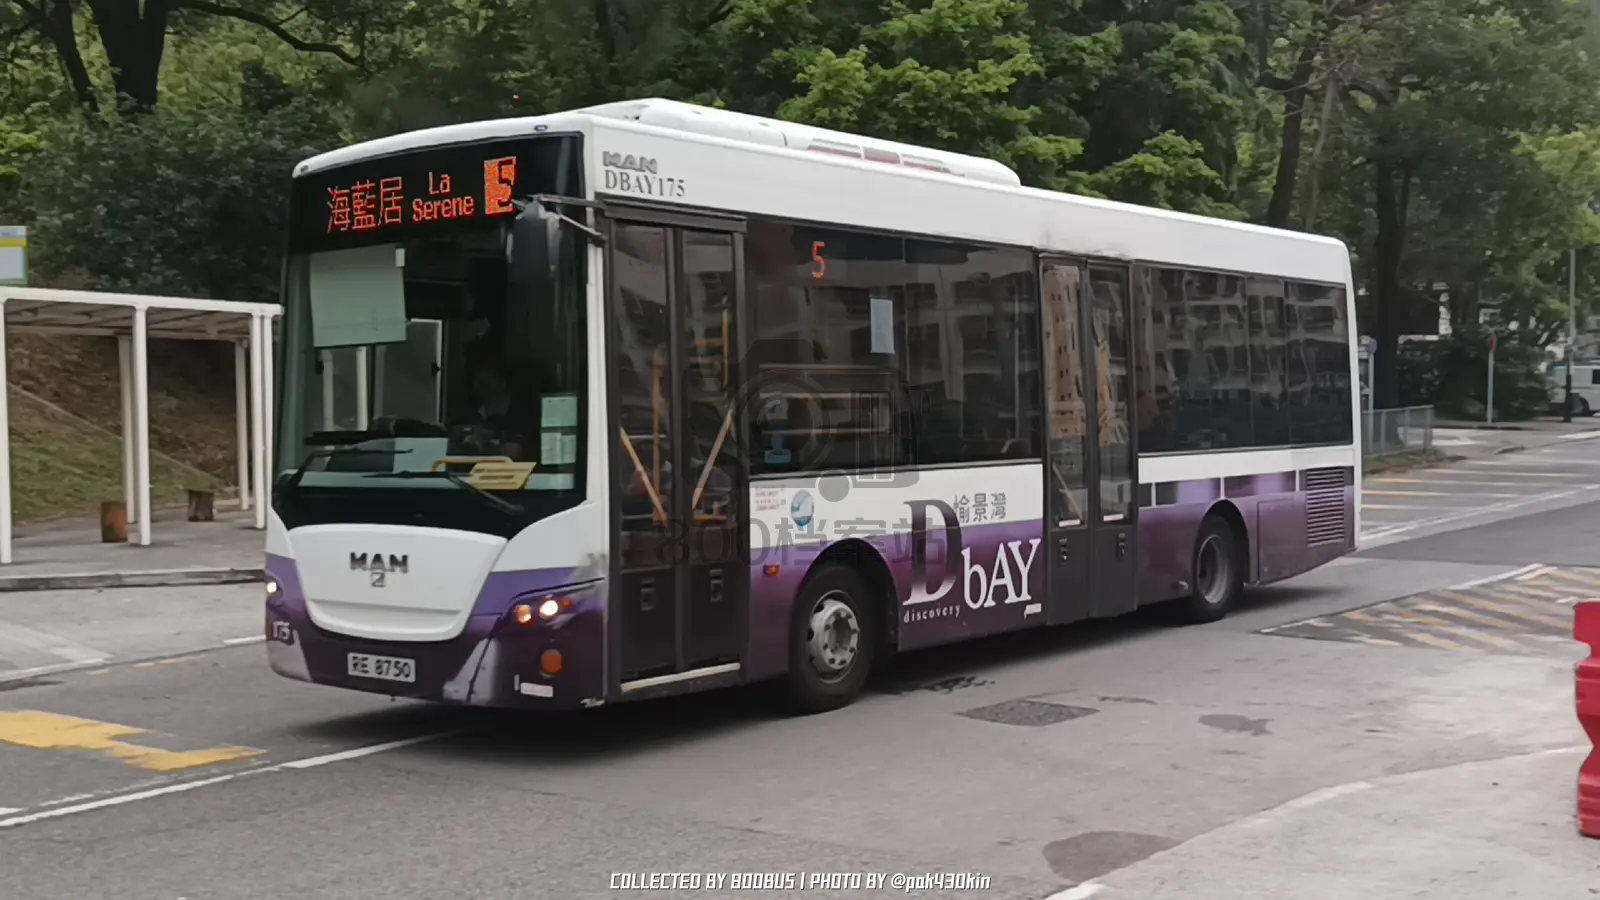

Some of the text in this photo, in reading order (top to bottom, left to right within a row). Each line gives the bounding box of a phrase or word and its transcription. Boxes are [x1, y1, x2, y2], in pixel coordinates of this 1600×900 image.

[603, 151, 658, 174] MAN
[428, 172, 451, 195] La
[484, 156, 516, 215] 5
[604, 169, 685, 198] DBAY175
[327, 176, 404, 233] 海藍居
[412, 196, 475, 222] Serene
[812, 241, 825, 279] 5
[953, 492, 1007, 522] 愉景灣
[350, 551, 409, 574] MAN
[903, 603, 961, 624] discovery
[352, 656, 412, 680] RE 8750
